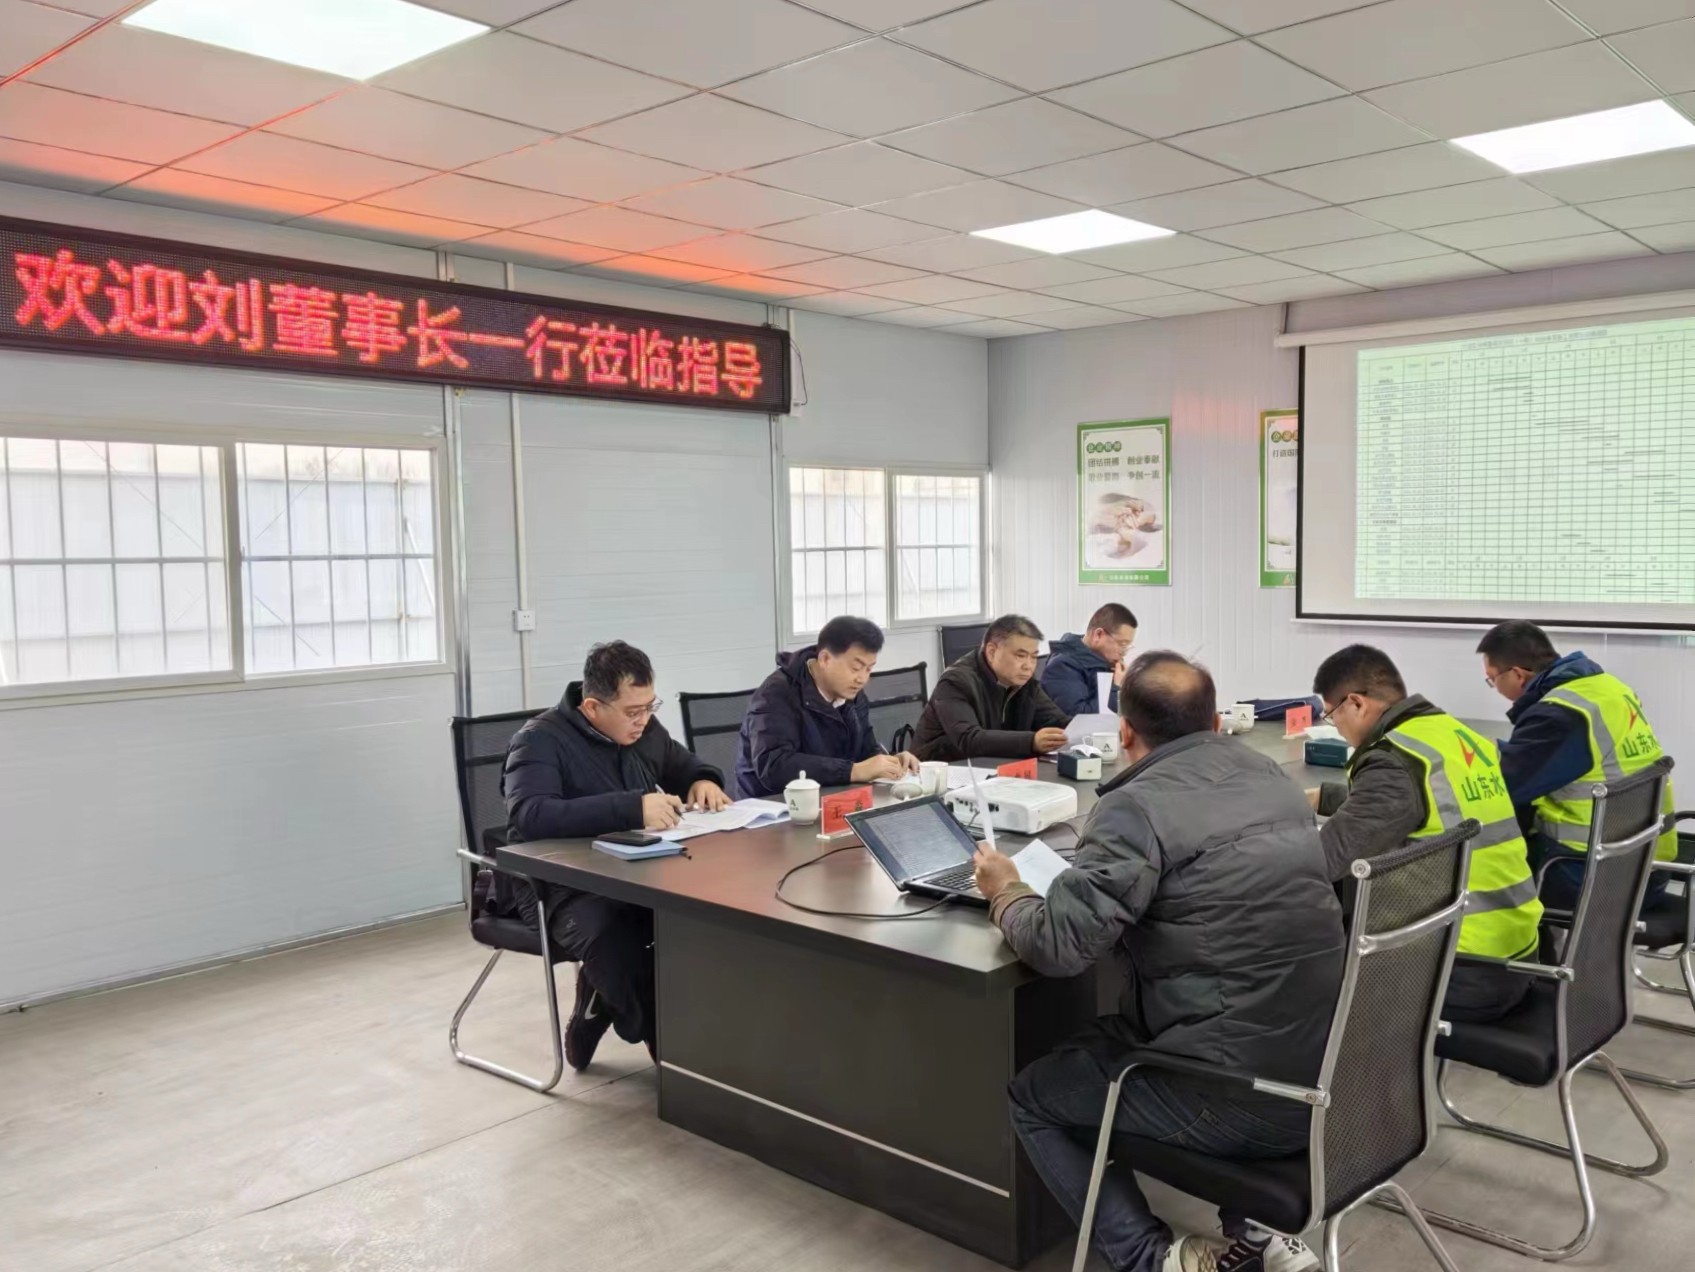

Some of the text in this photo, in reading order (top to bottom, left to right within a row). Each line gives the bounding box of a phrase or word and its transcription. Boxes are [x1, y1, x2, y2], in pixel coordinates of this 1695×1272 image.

[13, 249, 763, 400] 欢迎刘董事长一行莅临指导
[1461, 771, 1505, 802] 山东水
